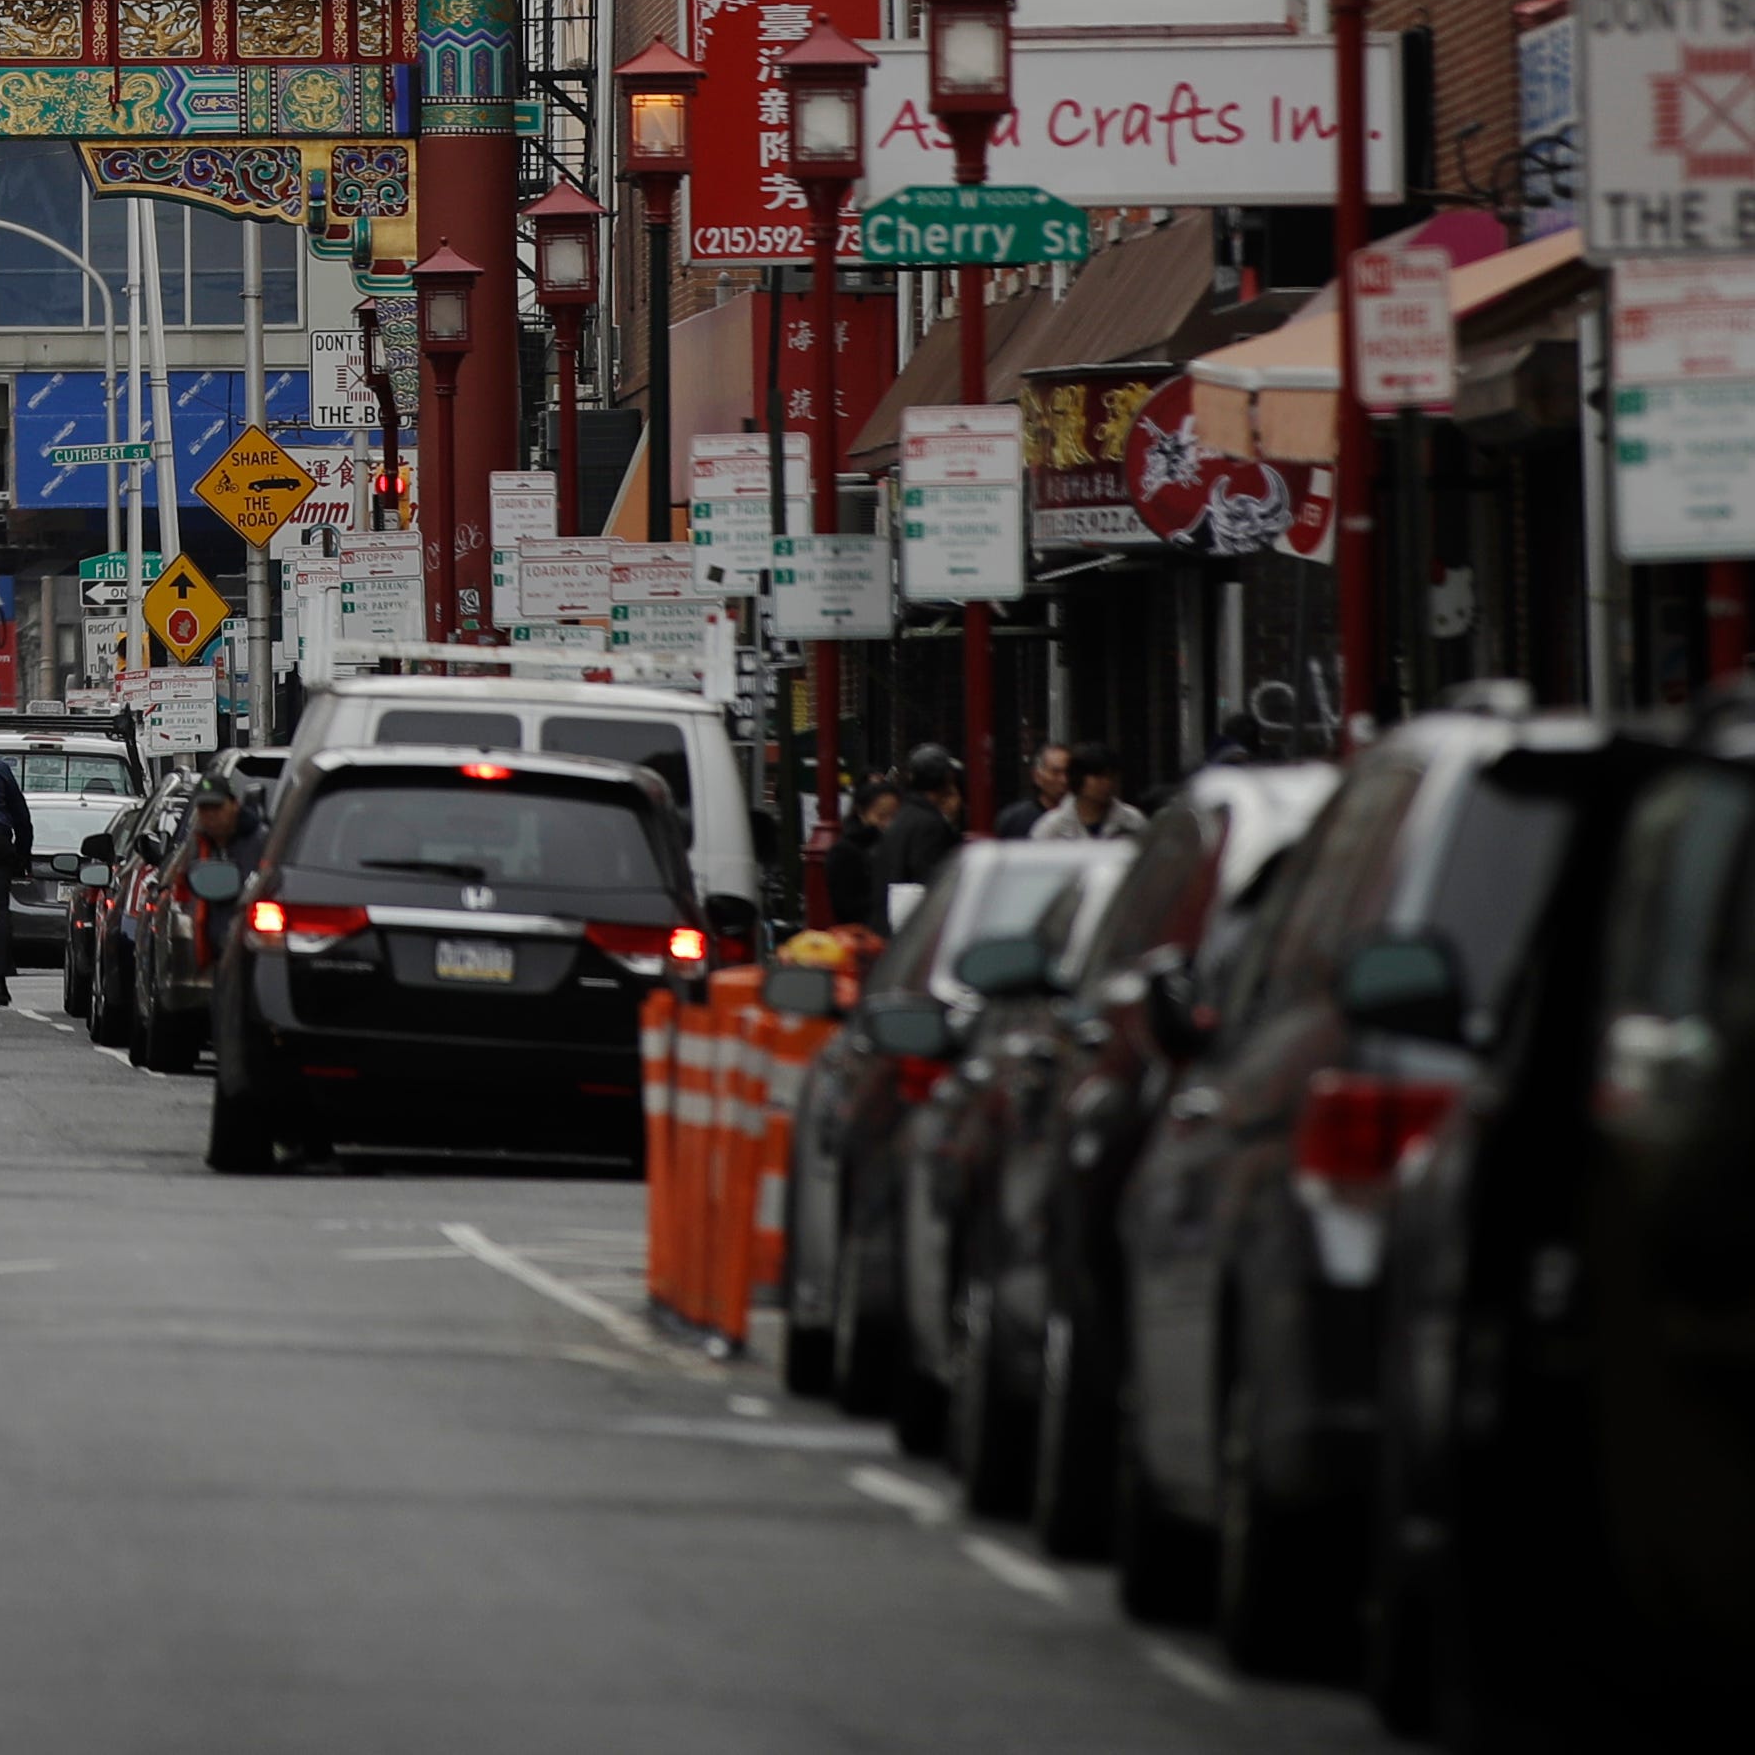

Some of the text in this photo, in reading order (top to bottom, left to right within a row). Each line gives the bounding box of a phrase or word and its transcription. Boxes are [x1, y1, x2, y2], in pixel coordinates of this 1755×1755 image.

[879, 82, 1382, 165] Asa Crafts In.
[1602, 189, 1706, 244] THE
[866, 213, 1083, 262] Cherry St
[317, 406, 354, 424] THE
[54, 446, 146, 463] CUTHBERT ST
[231, 450, 279, 467] SHARE
[244, 495, 271, 511] THE
[237, 511, 278, 528] ROAD
[355, 552, 405, 563] STOPPING
[95, 561, 152, 579] Filbt
[524, 564, 580, 578] LOADING
[370, 581, 410, 592] PARKING
